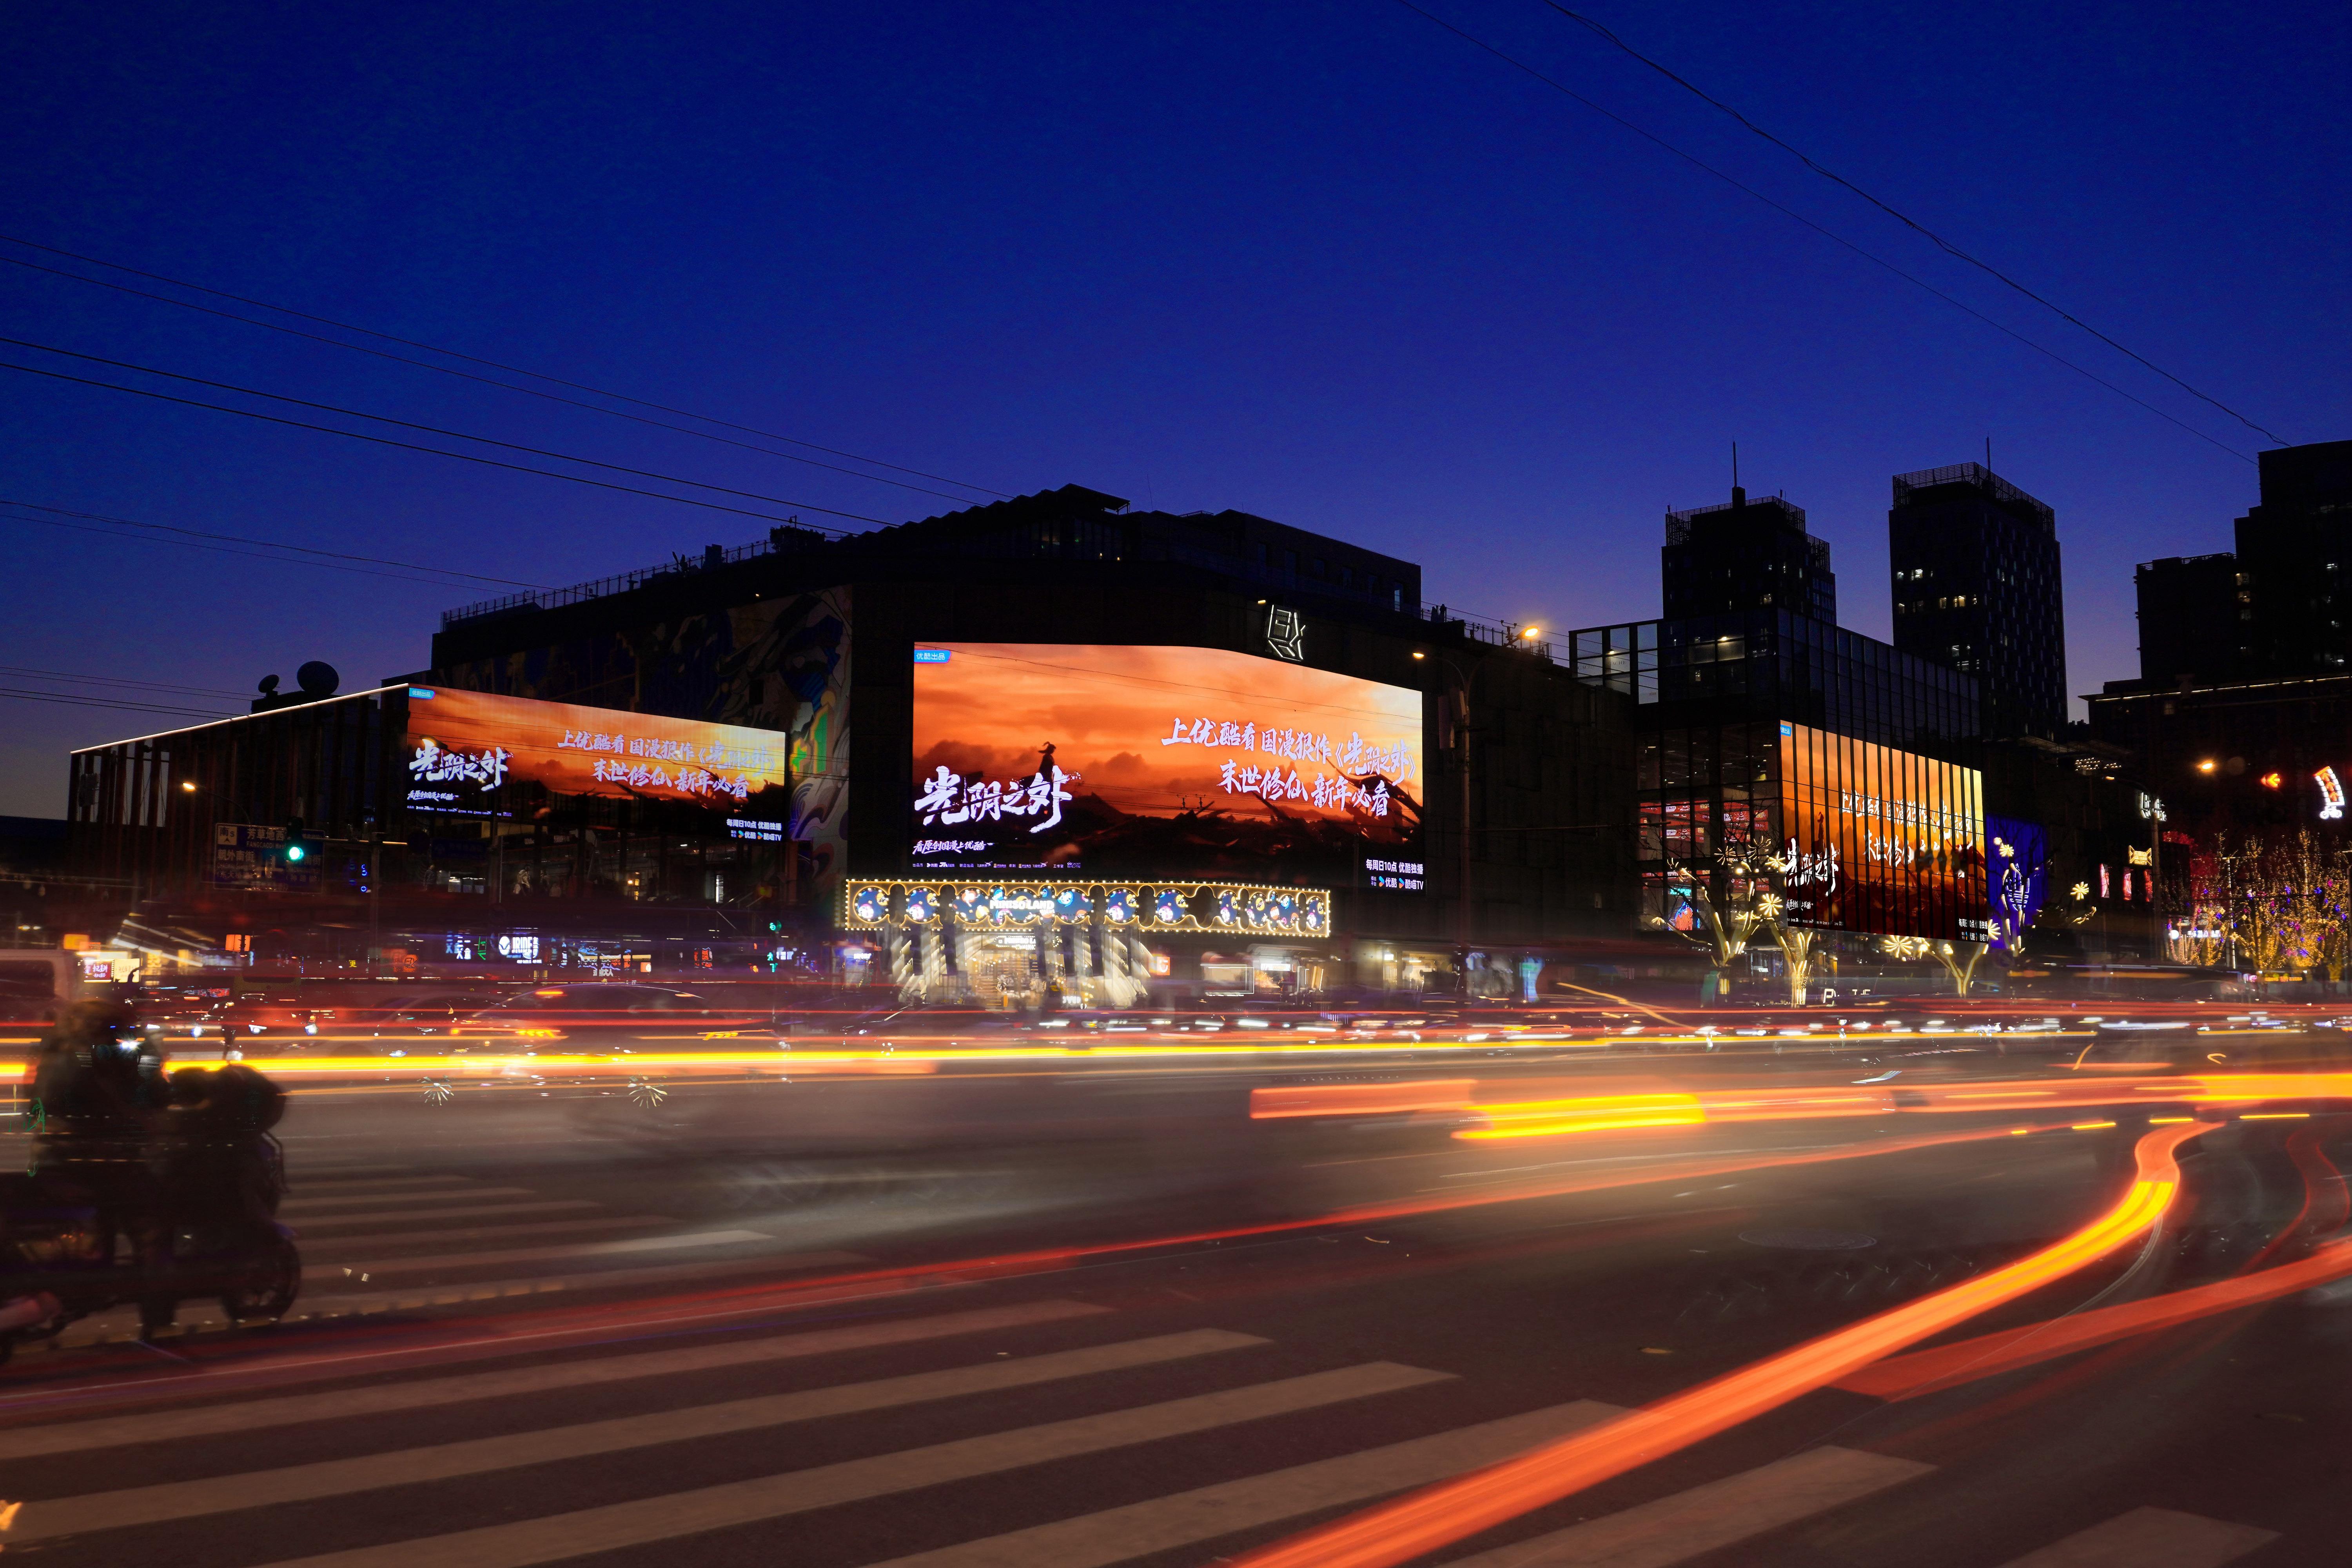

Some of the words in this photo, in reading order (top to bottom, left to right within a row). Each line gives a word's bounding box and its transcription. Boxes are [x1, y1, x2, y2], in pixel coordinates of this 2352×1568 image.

[557, 730, 625, 754] 上优酷看
[1161, 717, 1255, 751] 上优酷看
[409, 745, 511, 791] 光阴之外
[590, 758, 672, 788] 末世修仙
[674, 768, 750, 798] 新年必看
[1216, 759, 1308, 801] 末世修仙
[1310, 772, 1390, 817] 新年必看
[914, 765, 1076, 833] 光阴之外
[726, 818, 757, 829] 每周日10点
[758, 821, 782, 831] 优酷独播
[744, 831, 756, 839] 优酷
[912, 840, 986, 855] 看原创国漫上优酷
[1366, 858, 1397, 872] 每周日10点
[1399, 862, 1423, 875] 优酷独播
[1385, 877, 1397, 888] 优酷
[1405, 879, 1424, 890] 酷喵TV
[990, 899, 1026, 910] MINISO
[1027, 899, 1055, 910] LAND
